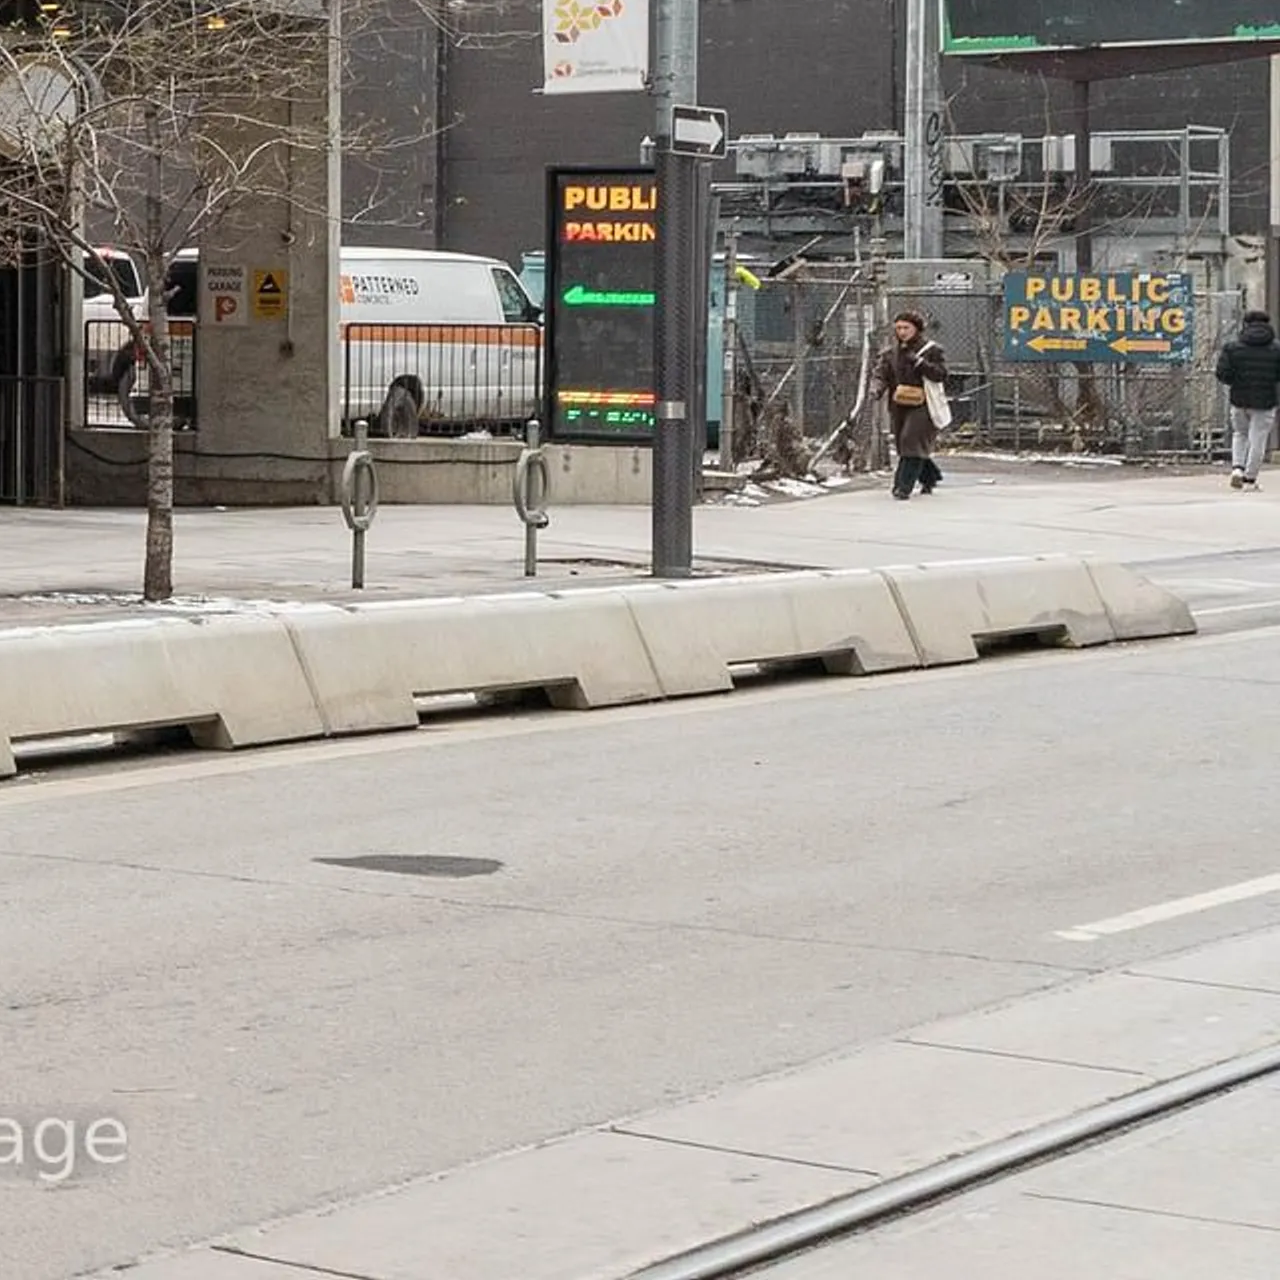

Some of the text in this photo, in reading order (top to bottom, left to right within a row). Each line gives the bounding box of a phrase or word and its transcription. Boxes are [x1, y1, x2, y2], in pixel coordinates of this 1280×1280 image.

[565, 186, 657, 211] PUBLI
[565, 222, 656, 241] PARKIN
[352, 275, 420, 296] PATTERNED
[1025, 276, 1170, 303] PUBLIC
[1009, 306, 1186, 333] PARKING
